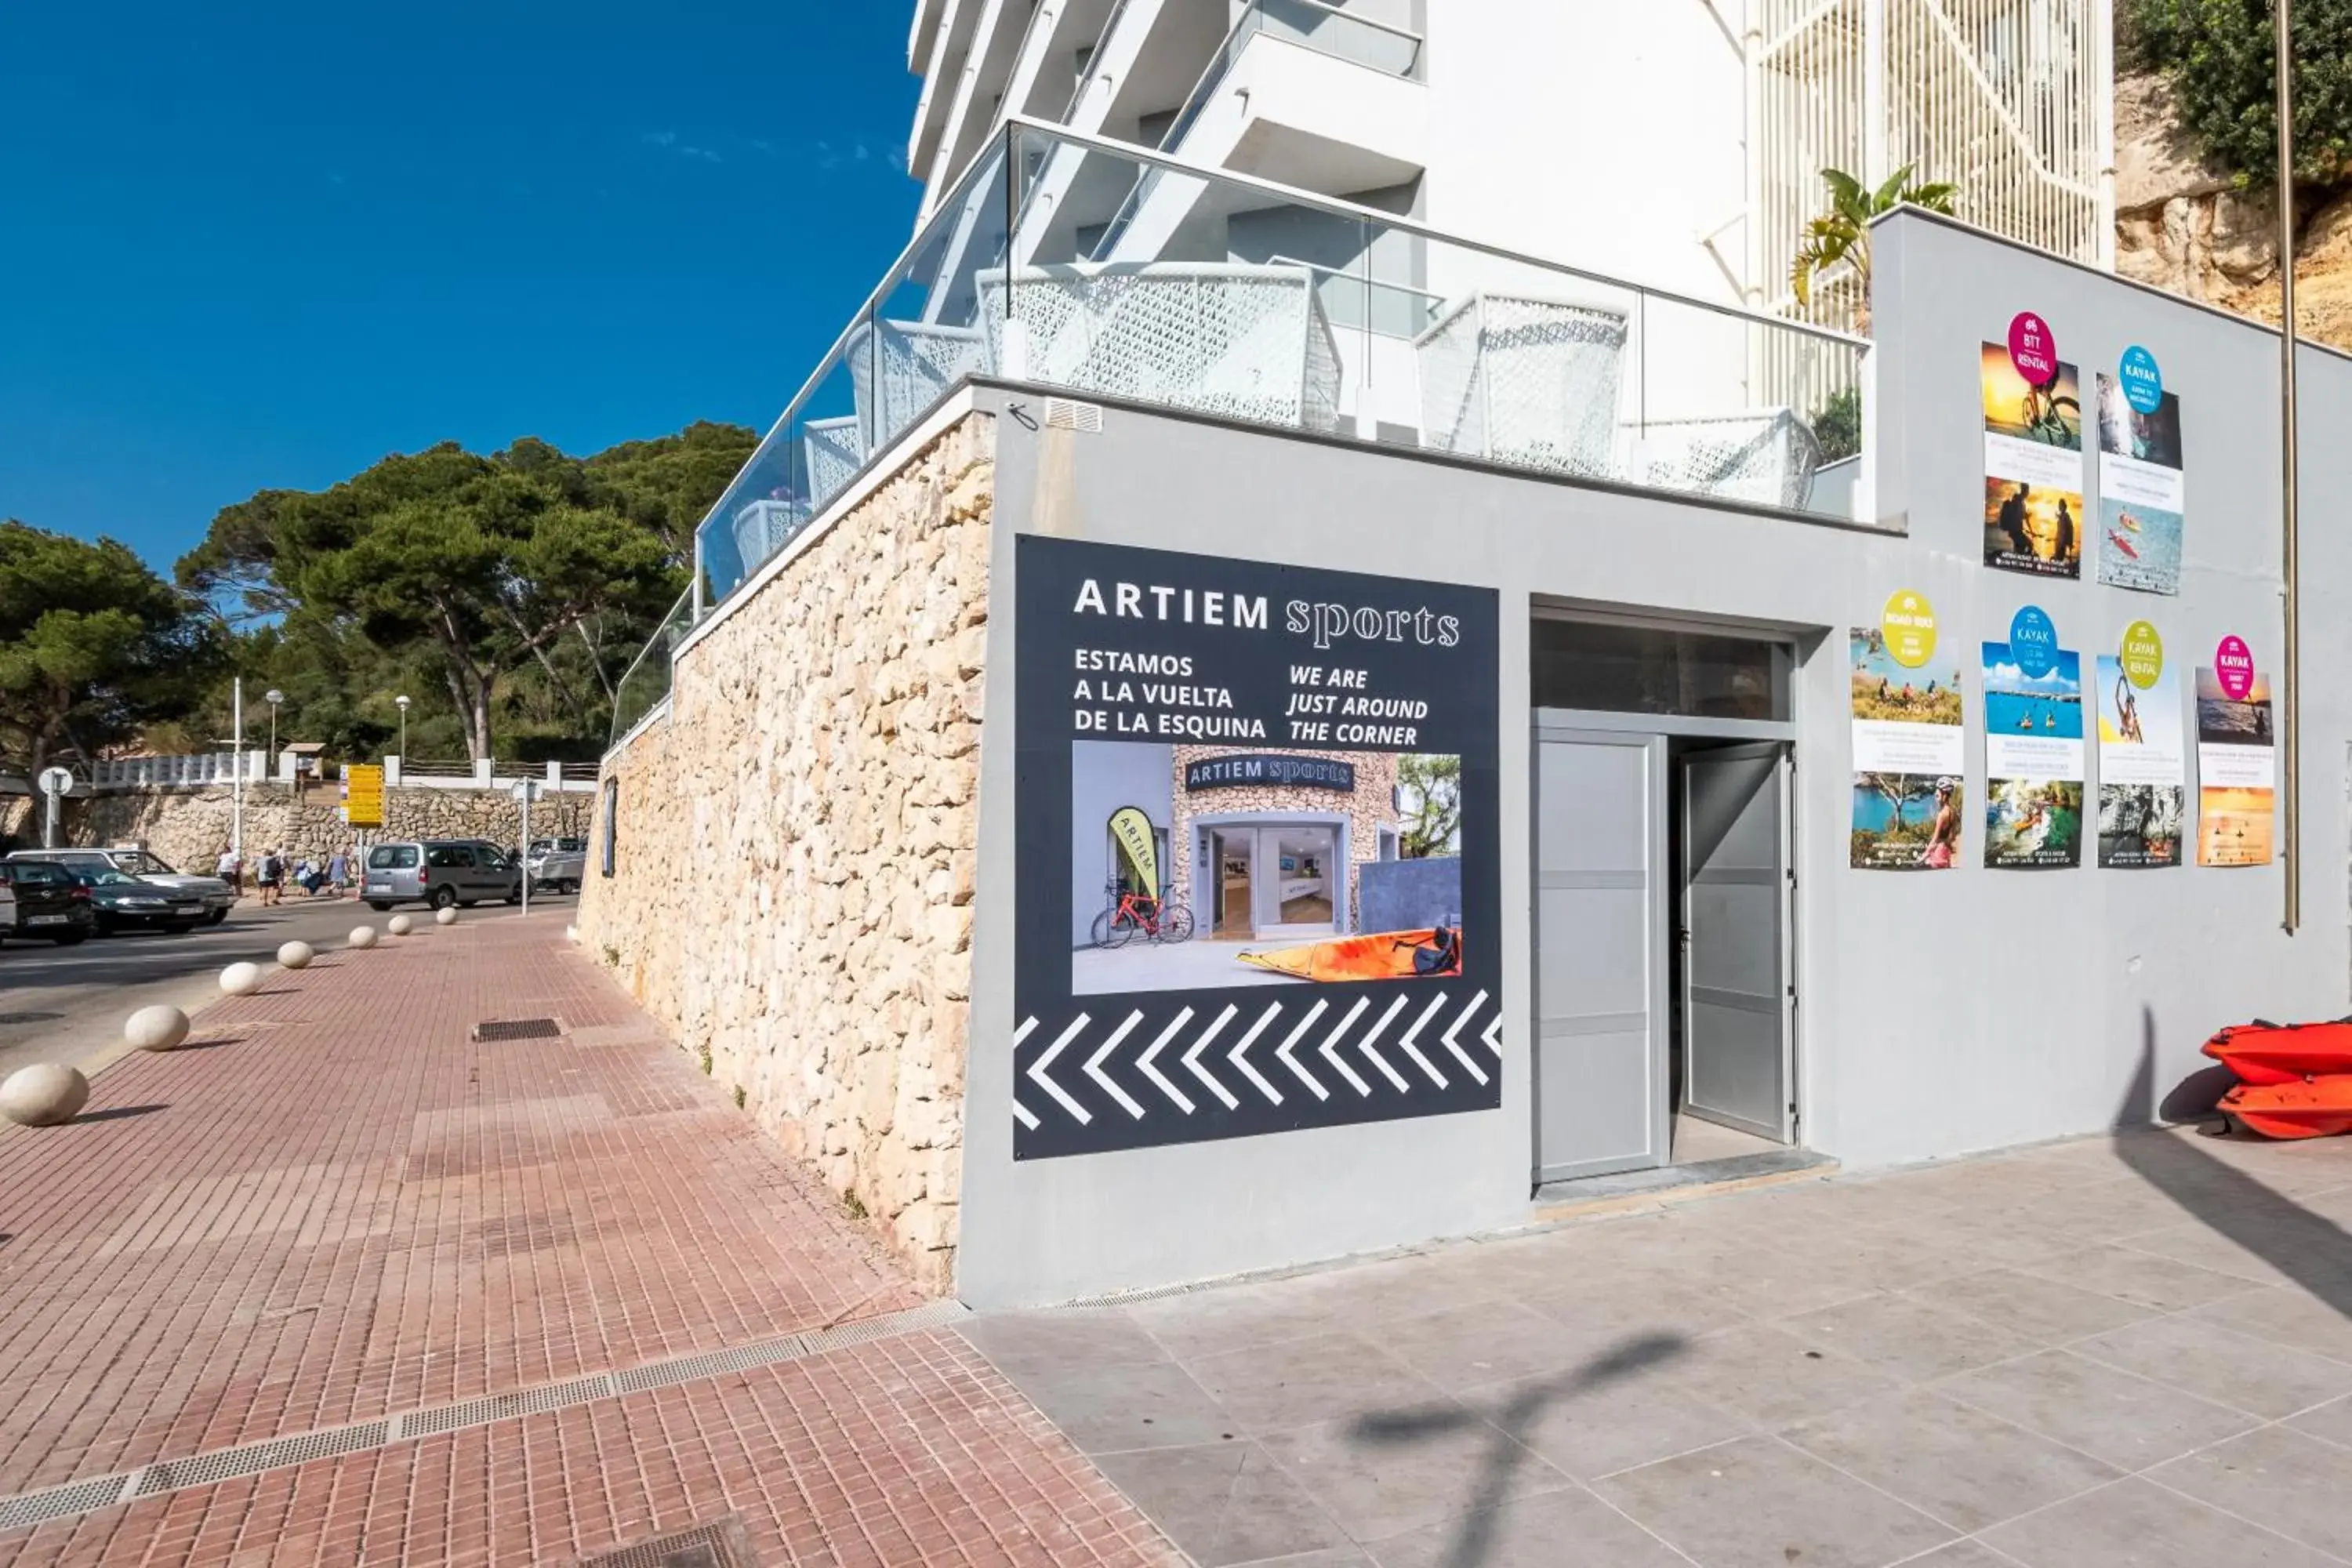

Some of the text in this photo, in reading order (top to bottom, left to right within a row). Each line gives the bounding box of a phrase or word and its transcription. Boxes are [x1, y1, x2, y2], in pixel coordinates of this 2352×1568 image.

[2024, 333, 2041, 350] BTT
[2017, 353, 2050, 372] RENTAL
[2125, 363, 2157, 383] KAYAK
[1073, 579, 1460, 649] ARTIEM sports
[2017, 626, 2050, 644] KAYAK
[2129, 641, 2158, 657] KAYAK
[1075, 648, 1193, 677] ESTAMOS
[2130, 660, 2158, 676] RENTAL
[2220, 654, 2249, 669] KAYAK
[1290, 665, 1368, 689] WE ARE
[1073, 679, 1234, 709] A LA VUELTA
[1285, 693, 1428, 720] JUST AROUND
[1075, 710, 1266, 739] DE LA ESQUINA
[1290, 721, 1417, 746] THE CORNER
[1191, 760, 1349, 784] ARTIEM sports
[1120, 818, 1152, 869] ARTIEM
